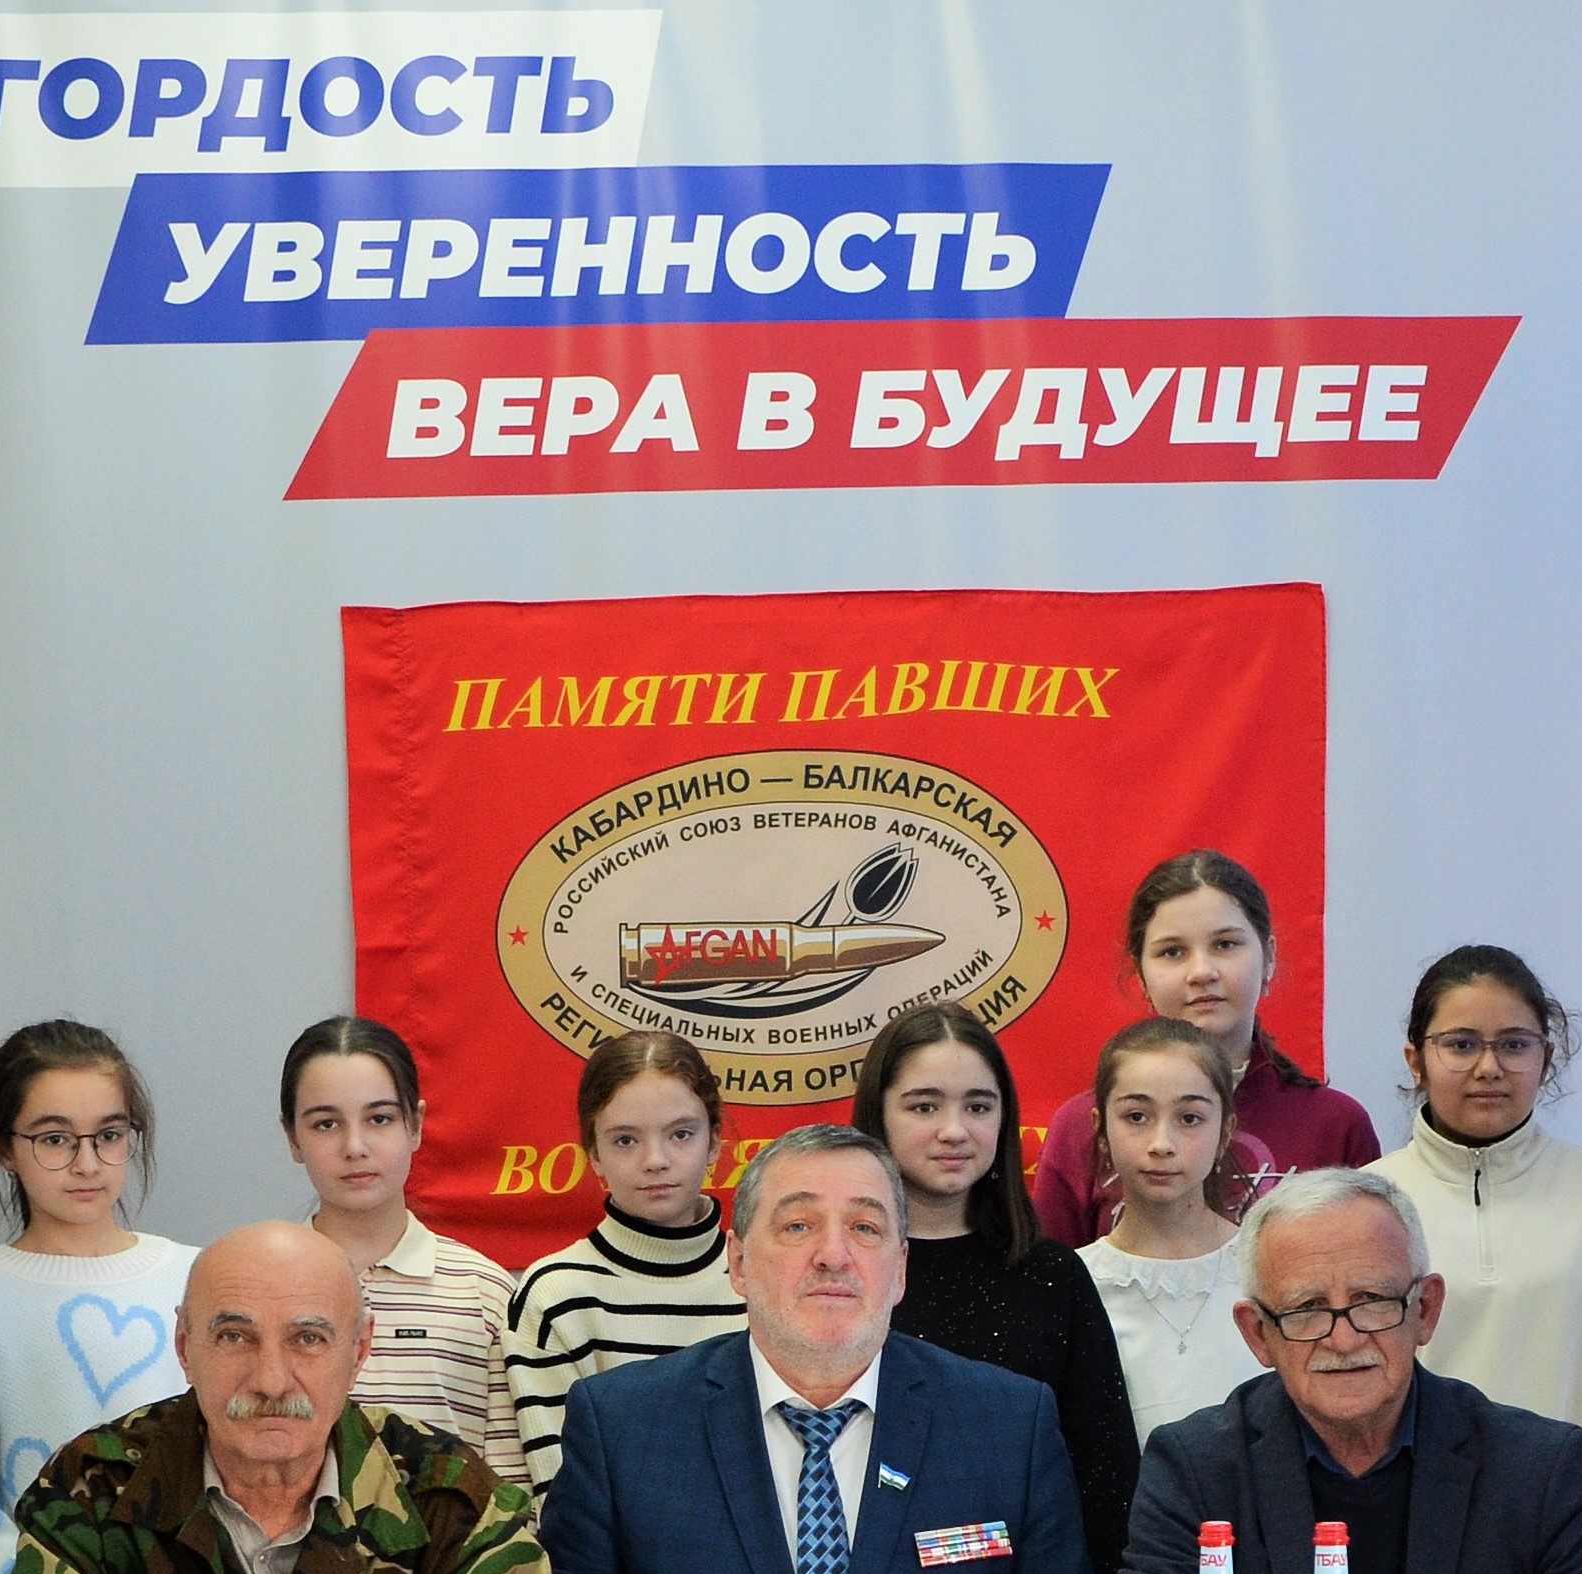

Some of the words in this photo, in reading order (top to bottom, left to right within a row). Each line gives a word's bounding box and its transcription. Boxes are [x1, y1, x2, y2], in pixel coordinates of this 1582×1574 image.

[163, 211, 1037, 304] УВЕРЕННОСТЬ
[386, 375, 699, 457] ВЕРА
[736, 372, 817, 450] В
[849, 364, 1427, 459] БУДУЩЕЕ
[442, 672, 767, 732] ПАМЯТИ
[778, 660, 1120, 723] ПАВШИХ
[550, 767, 750, 864] КАБАРДИНО
[803, 763, 1019, 848] БАЛКАРСКАЯ
[554, 830, 670, 934] РОССИЙСКИЙ
[679, 816, 742, 842] СОЮЗ
[753, 811, 877, 831] ВЕТЕРАНОВ
[887, 819, 1011, 919] АФГАНИСТАНА
[571, 964, 587, 983] И
[591, 983, 756, 1045] СПЕЦИАЛЬНЫХ
[767, 1013, 878, 1044] ВОЕННЫХ
[1200, 1553, 1227, 1567] БАУ
